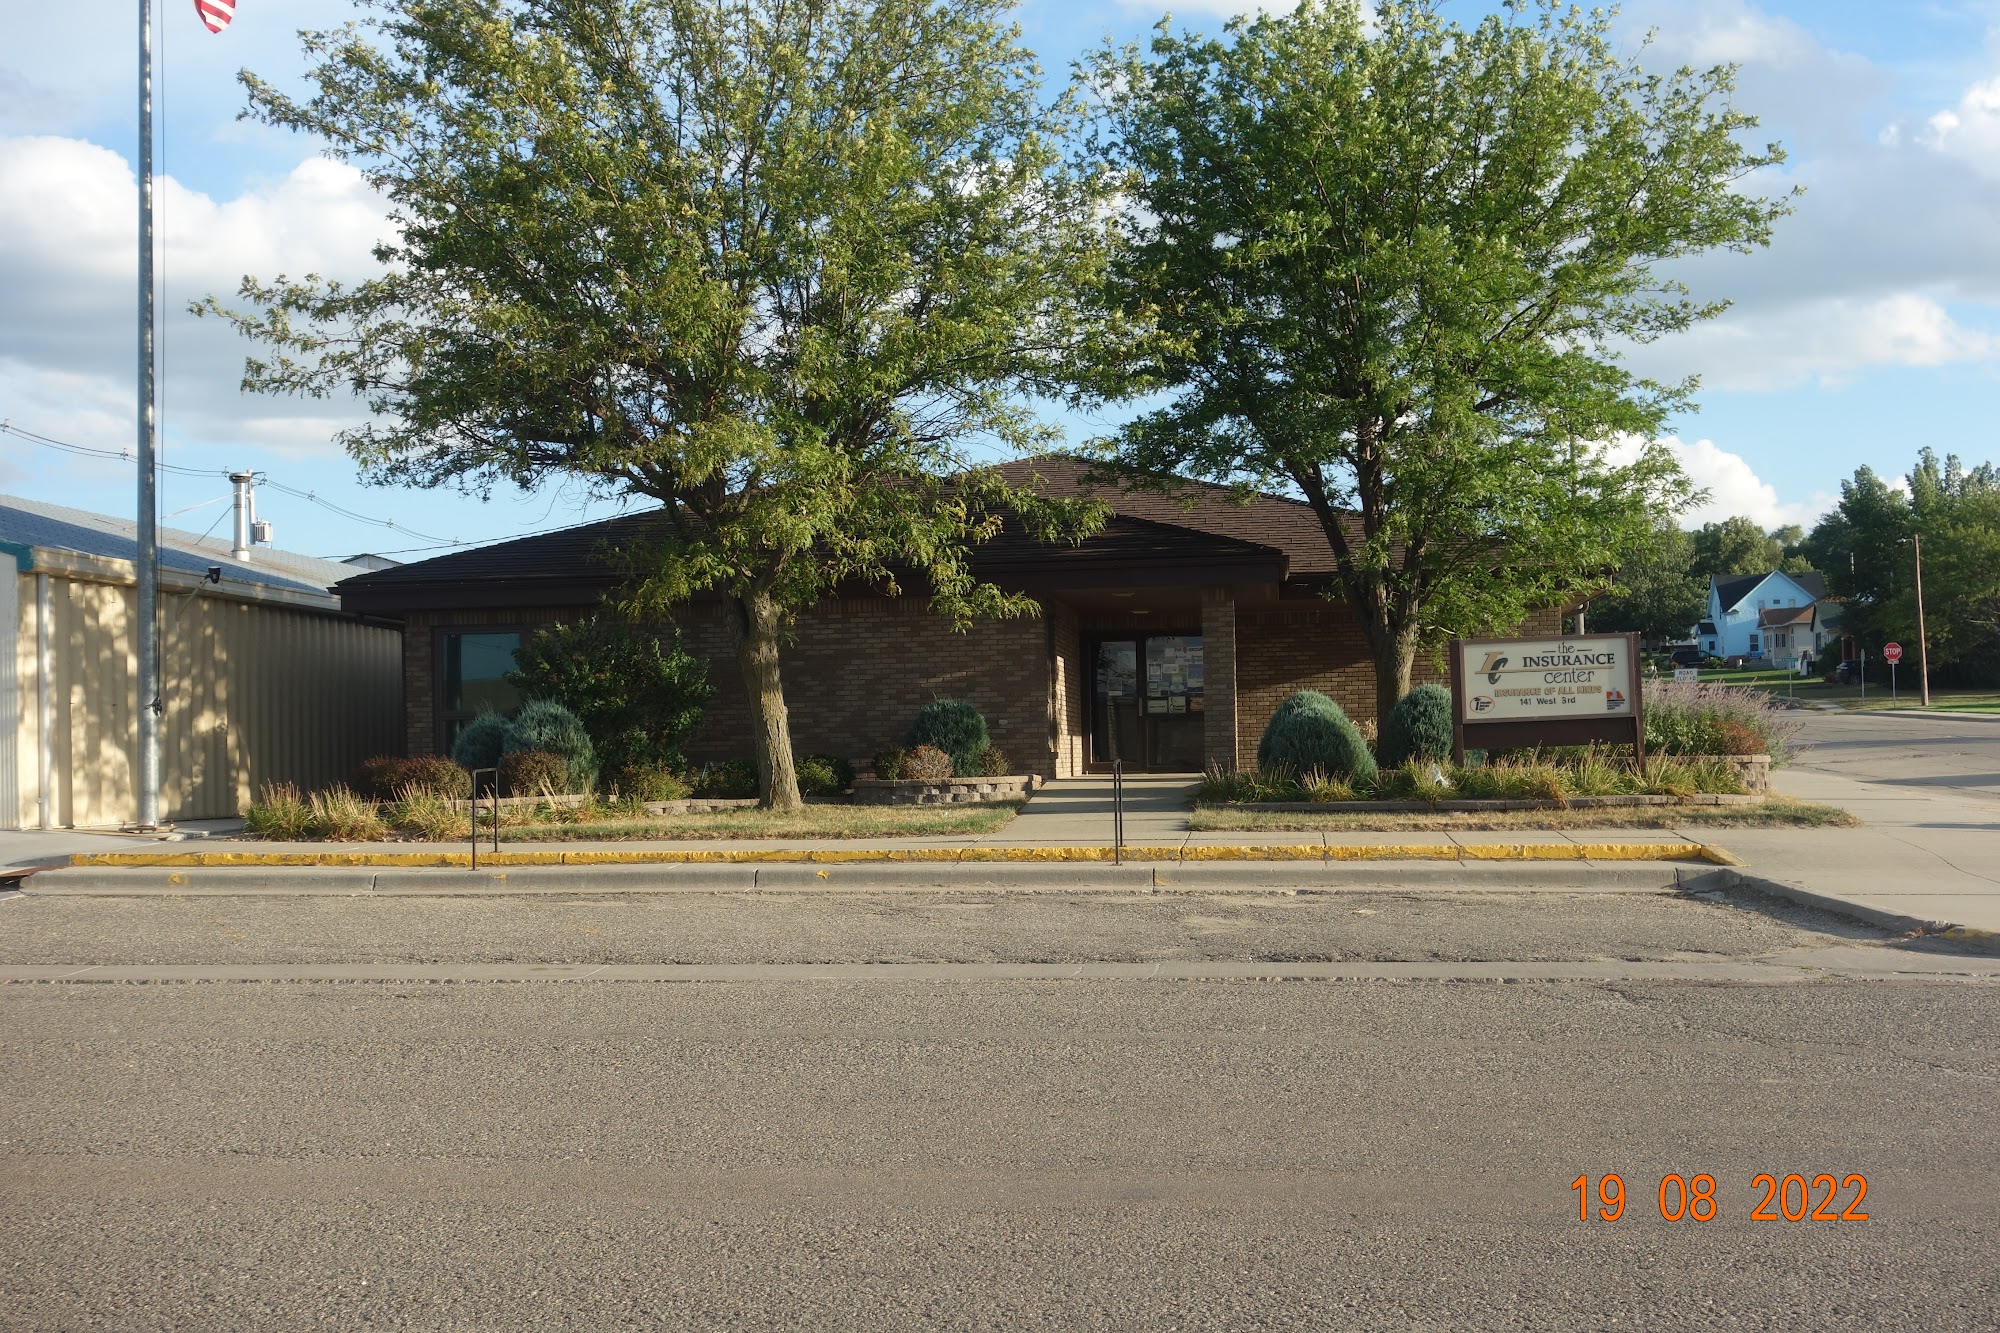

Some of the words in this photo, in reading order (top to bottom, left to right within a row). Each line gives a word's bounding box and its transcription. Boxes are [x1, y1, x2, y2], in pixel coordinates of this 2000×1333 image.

[1557, 641, 1575, 654] the
[1885, 647, 1901, 655] STOP
[1522, 653, 1615, 668] INSURANCE
[1544, 667, 1595, 684] center
[1494, 687, 1542, 698] INSURANCE
[1544, 686, 1555, 696] OF
[1557, 686, 1575, 695] ALL
[1576, 685, 1603, 695] KINDS
[1520, 697, 1532, 706] 141
[1536, 696, 1557, 706] West
[1561, 696, 1576, 705] 3rd
